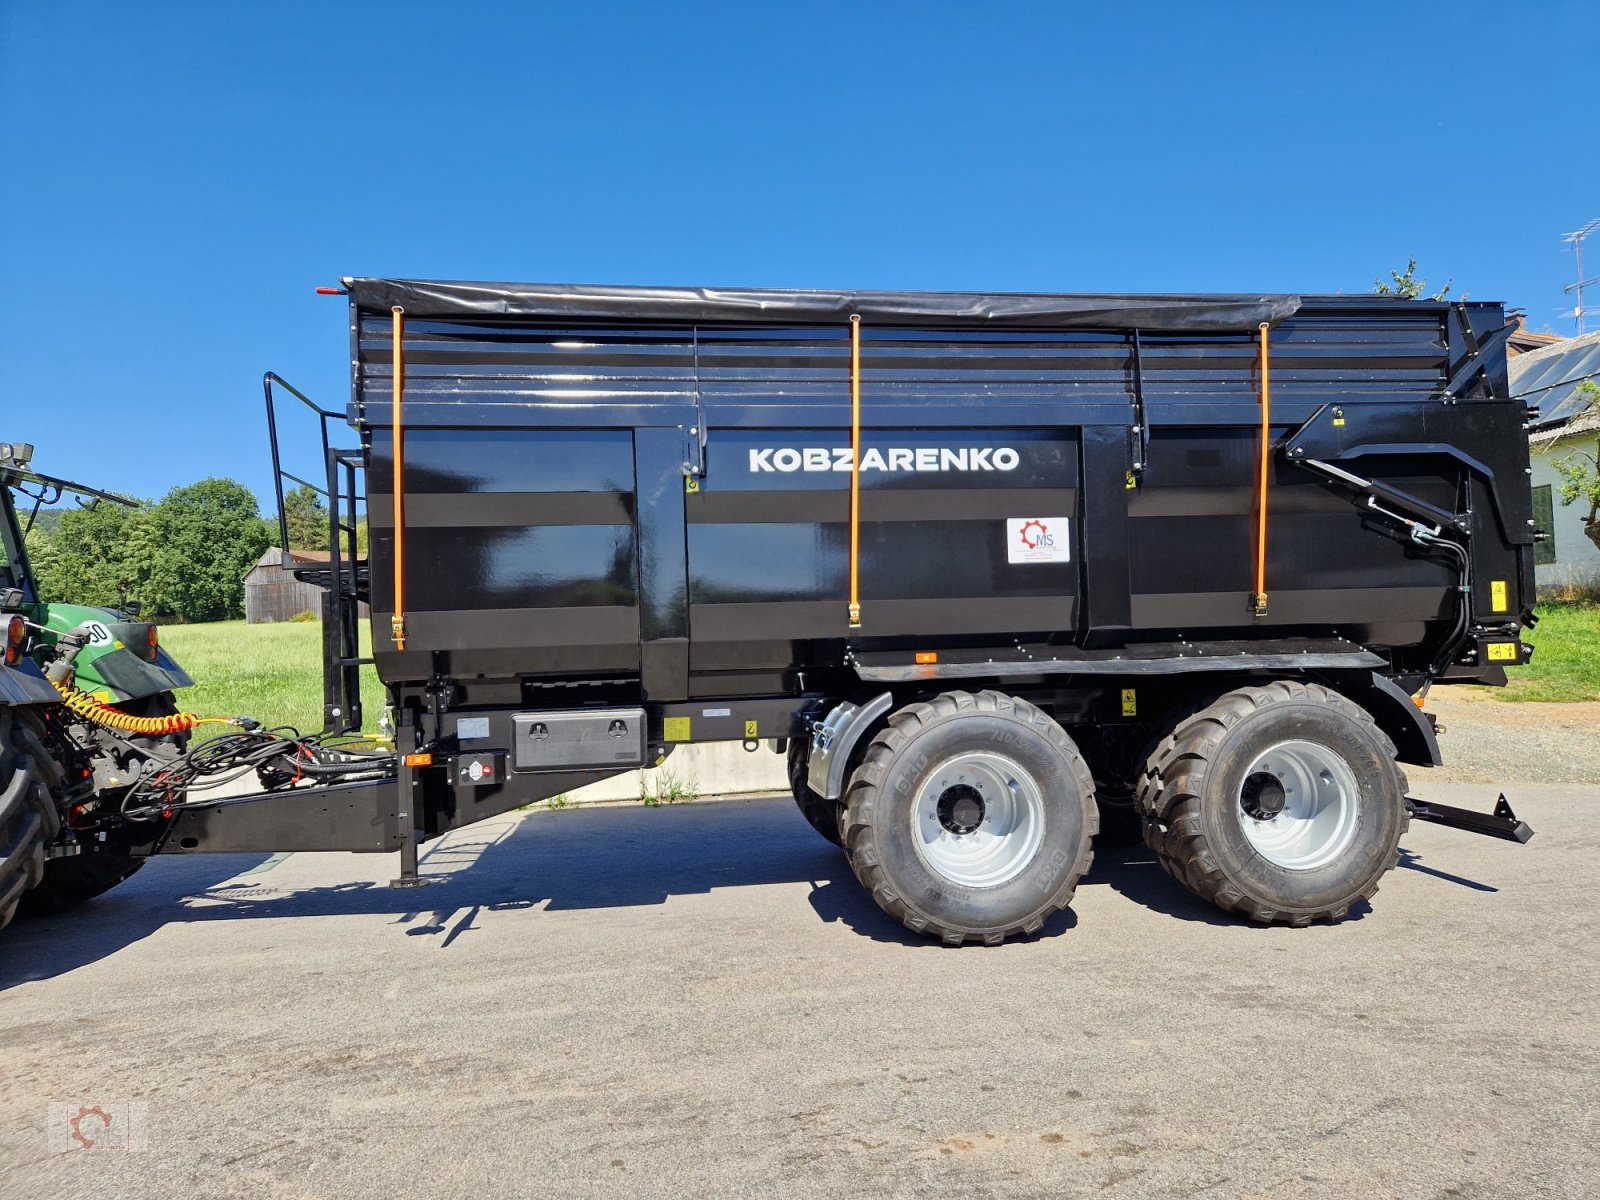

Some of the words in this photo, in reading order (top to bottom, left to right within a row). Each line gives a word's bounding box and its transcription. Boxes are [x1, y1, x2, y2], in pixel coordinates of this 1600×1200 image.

[749, 447, 1020, 473] KOBZARENKO
[1036, 534, 1054, 546] MS
[87, 624, 108, 643] 50
